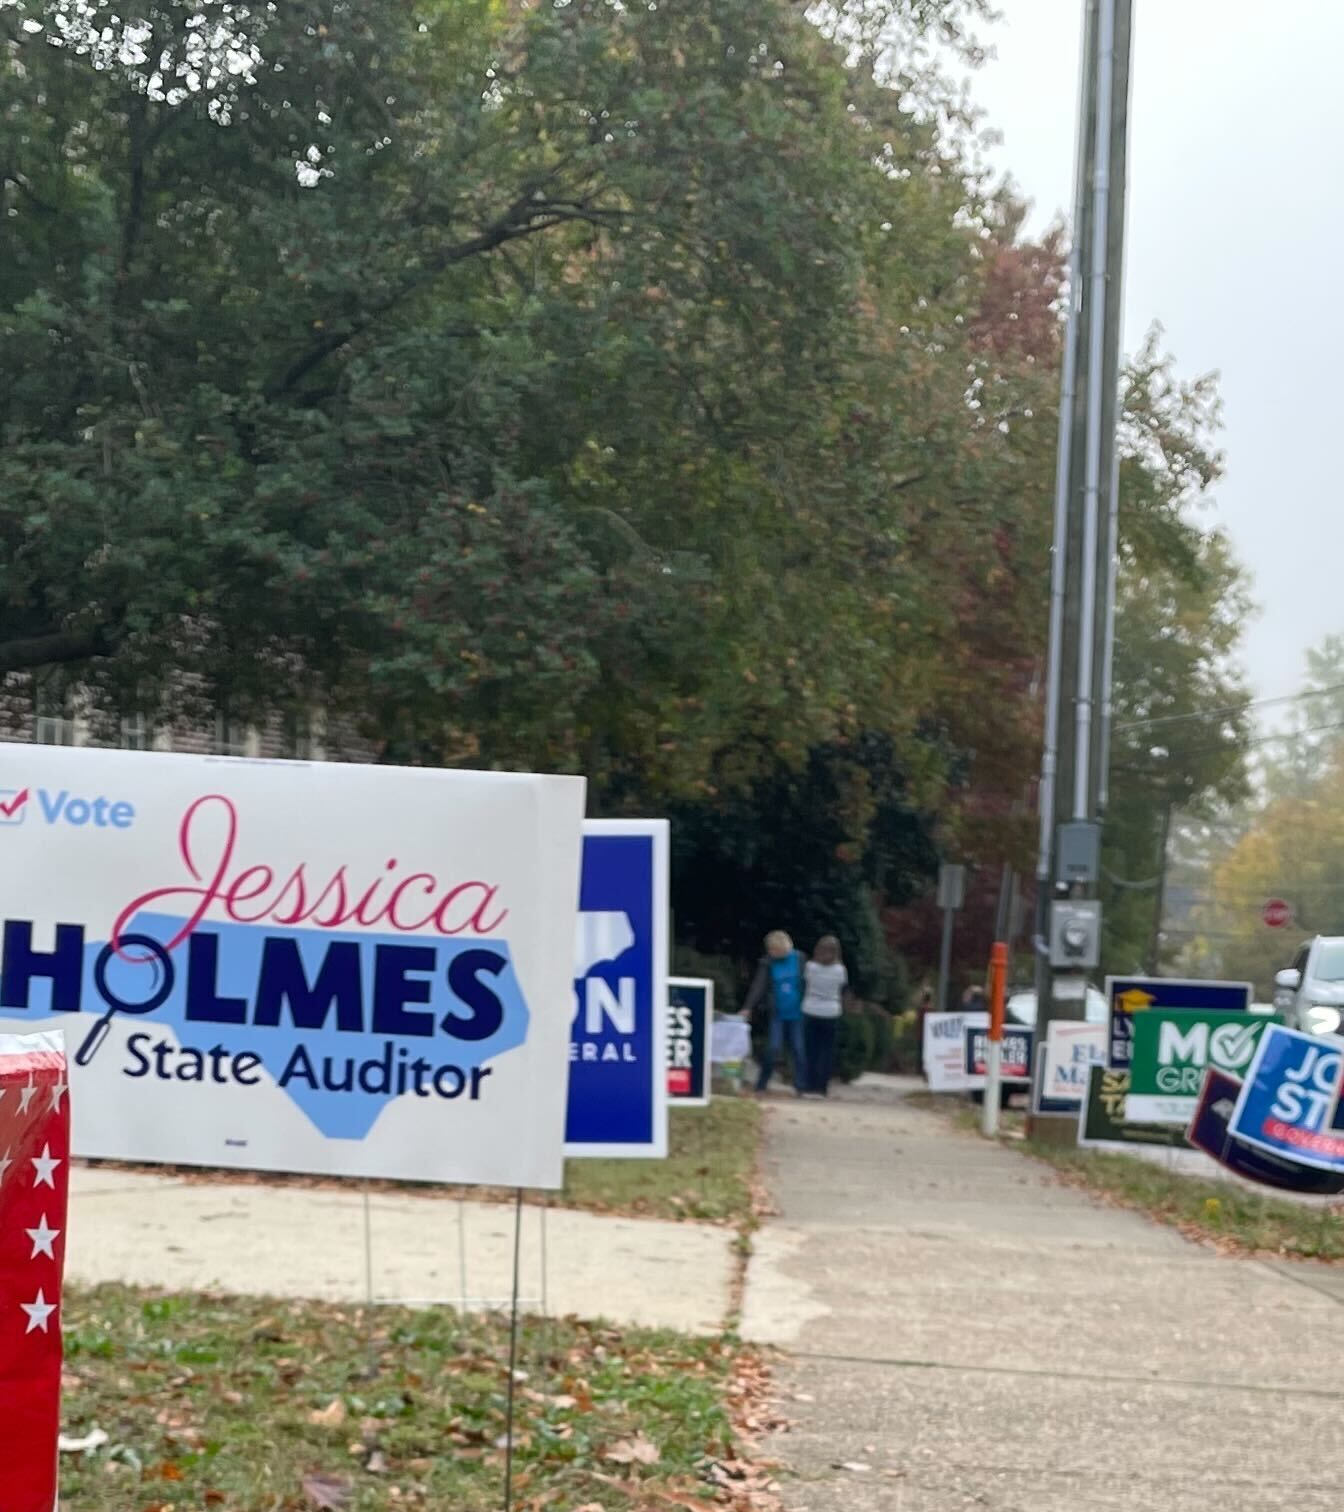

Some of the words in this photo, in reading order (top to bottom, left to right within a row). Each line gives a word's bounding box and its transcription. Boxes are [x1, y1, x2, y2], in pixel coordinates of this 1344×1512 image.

[38, 789, 135, 829] Vote
[112, 794, 509, 963] Jessica
[123, 1033, 263, 1085] State
[278, 1041, 493, 1100] Auditor
[568, 1042, 637, 1062] ERAL
